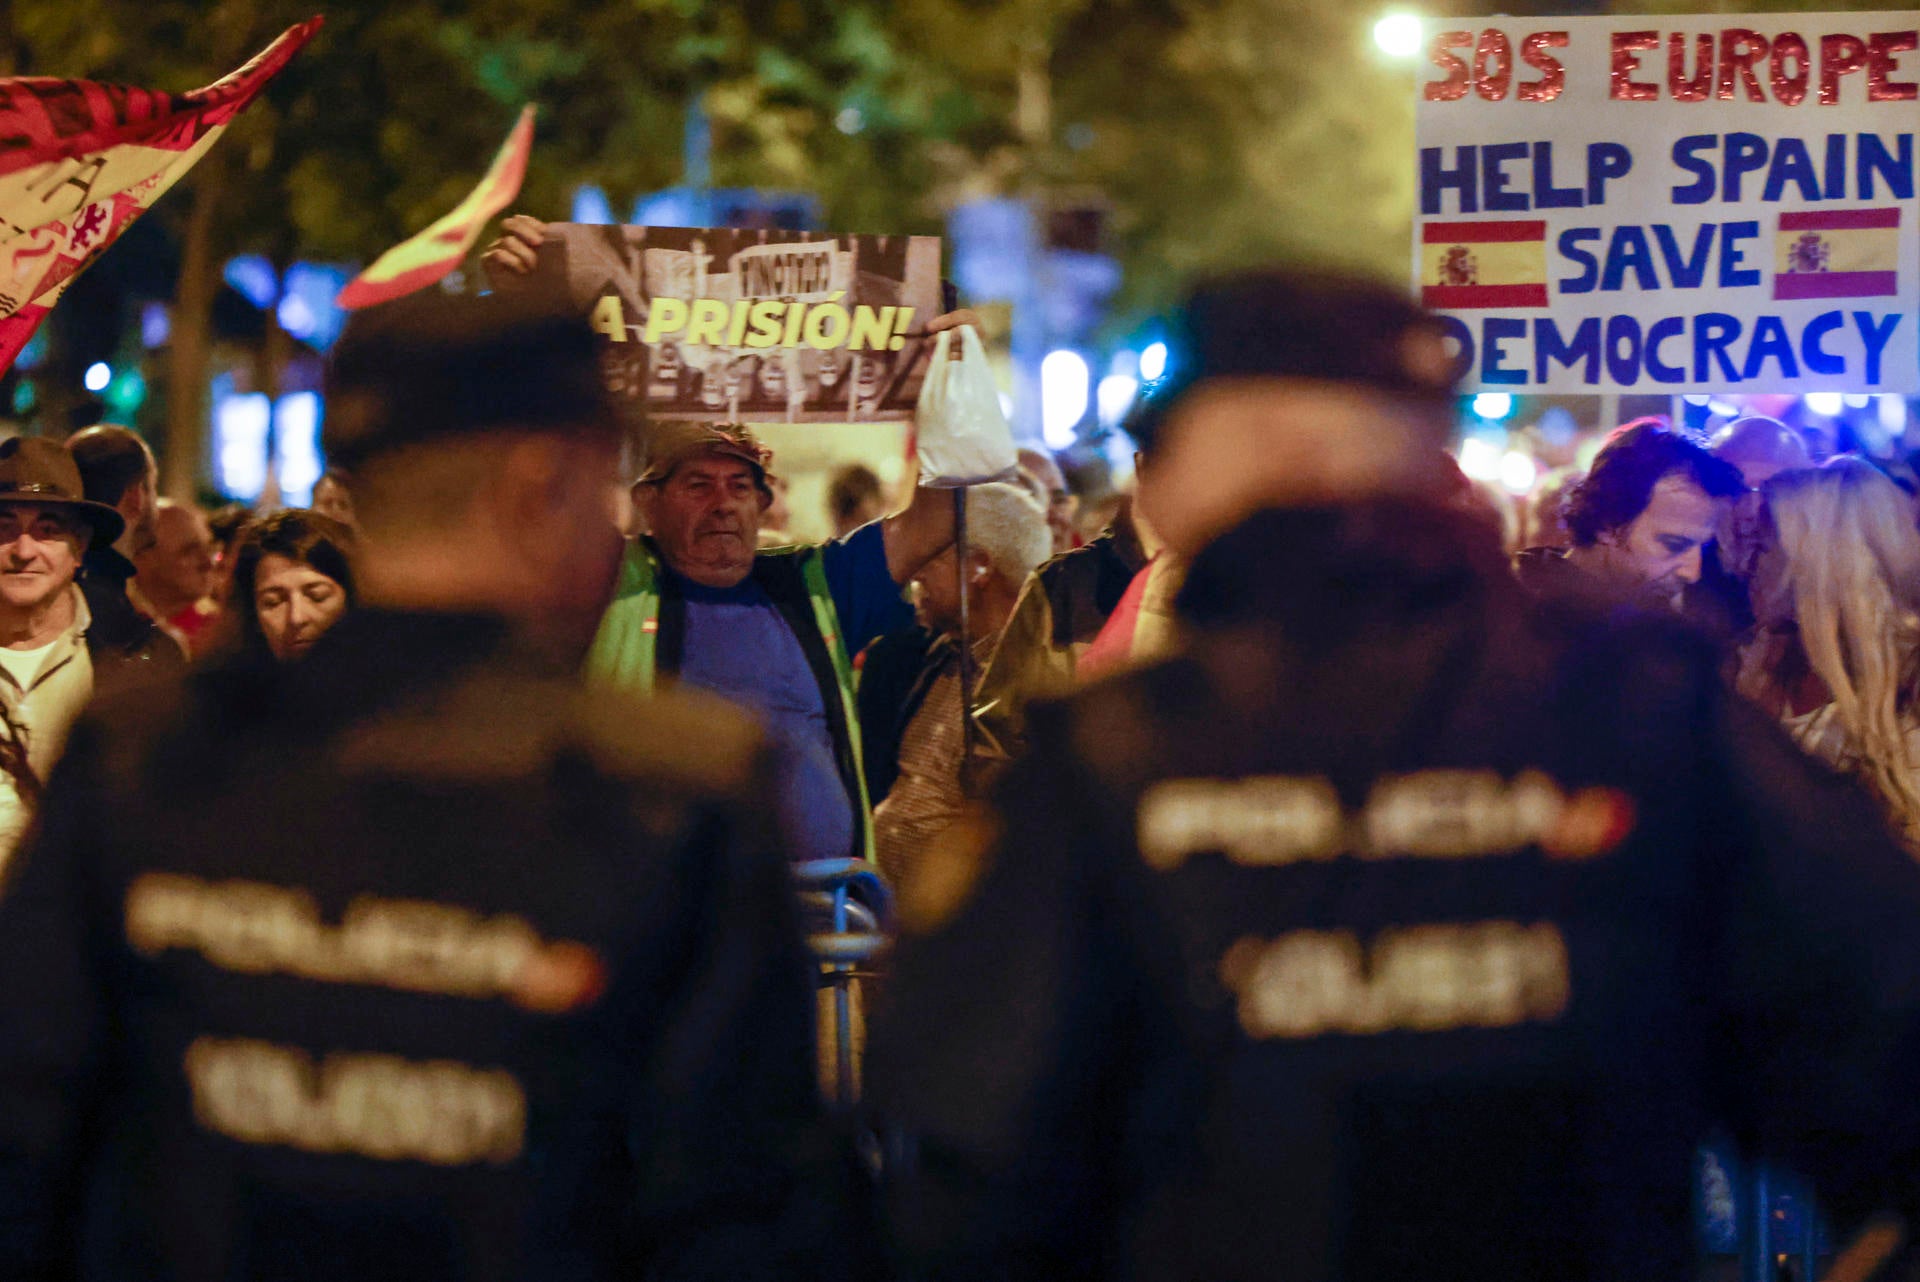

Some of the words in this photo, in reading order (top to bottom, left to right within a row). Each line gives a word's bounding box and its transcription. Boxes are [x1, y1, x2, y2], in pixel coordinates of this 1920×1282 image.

[1423, 28, 1570, 102] SOS
[1610, 28, 1919, 106] EUROPE
[1420, 140, 1634, 214] HELP
[1672, 132, 1915, 204] SPAIN
[1557, 220, 1761, 294] SAVE
[644, 290, 916, 352] PRISIÓN!
